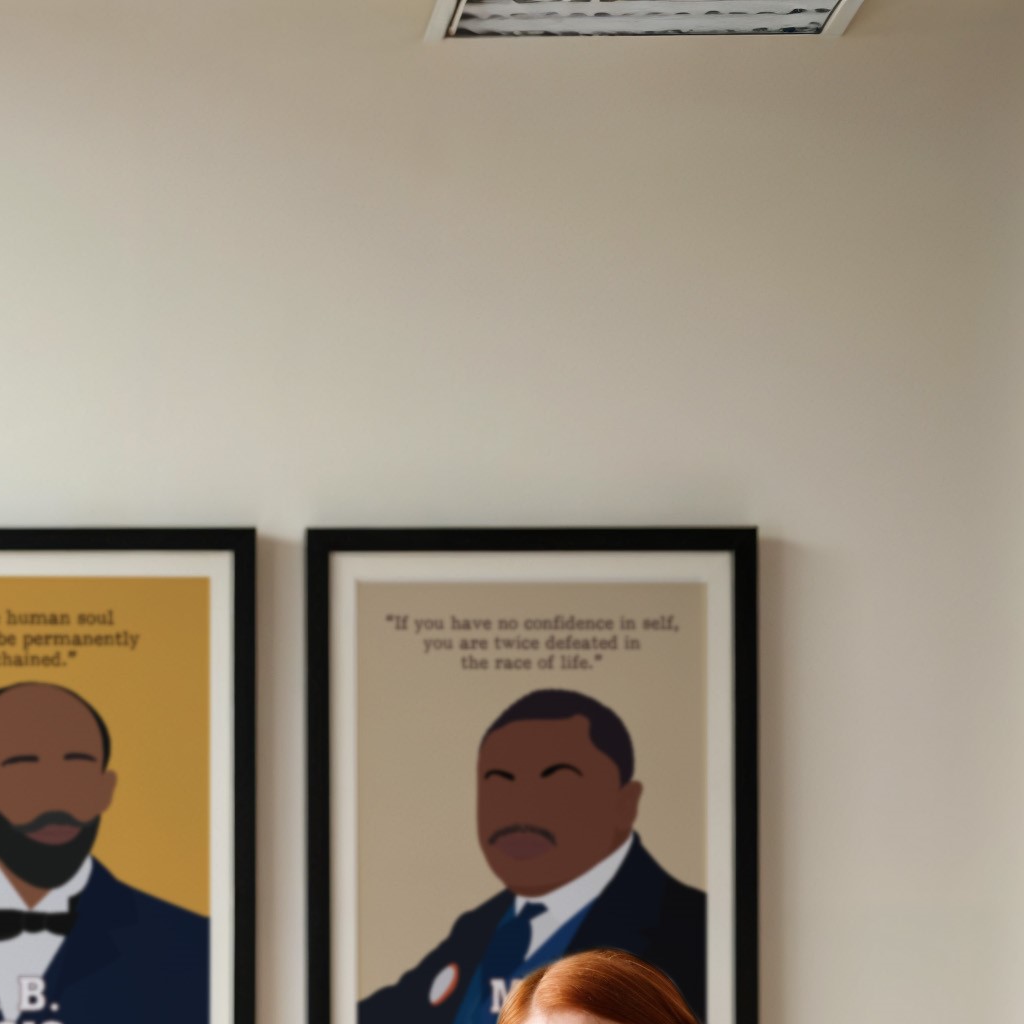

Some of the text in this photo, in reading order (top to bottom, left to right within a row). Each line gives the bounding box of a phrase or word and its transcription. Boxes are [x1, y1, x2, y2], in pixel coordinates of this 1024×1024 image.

[6, 608, 71, 626] human
[77, 608, 115, 626] soul
[386, 613, 680, 634] "If you have no confidence in self,
[23, 629, 140, 650] permanently
[424, 634, 641, 654] you are twice defeated in
[461, 653, 604, 671] the race of life."
[18, 976, 59, 1012] B.
